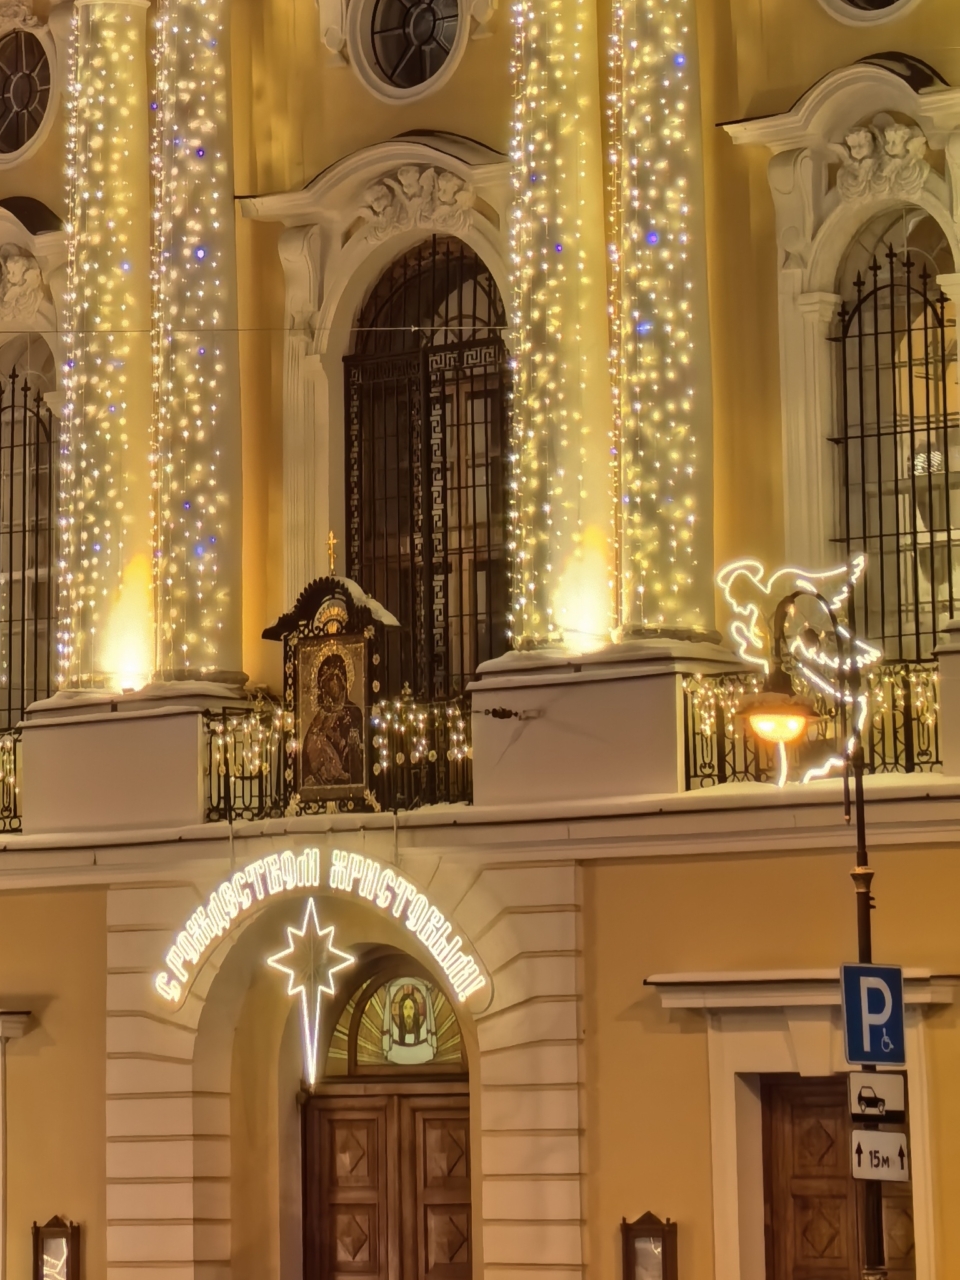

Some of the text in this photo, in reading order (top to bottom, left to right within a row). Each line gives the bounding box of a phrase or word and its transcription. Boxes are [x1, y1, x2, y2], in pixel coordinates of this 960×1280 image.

[165, 847, 320, 983] РОЖДЕСТВОМ
[154, 971, 182, 1003] С
[860, 976, 892, 1052] P
